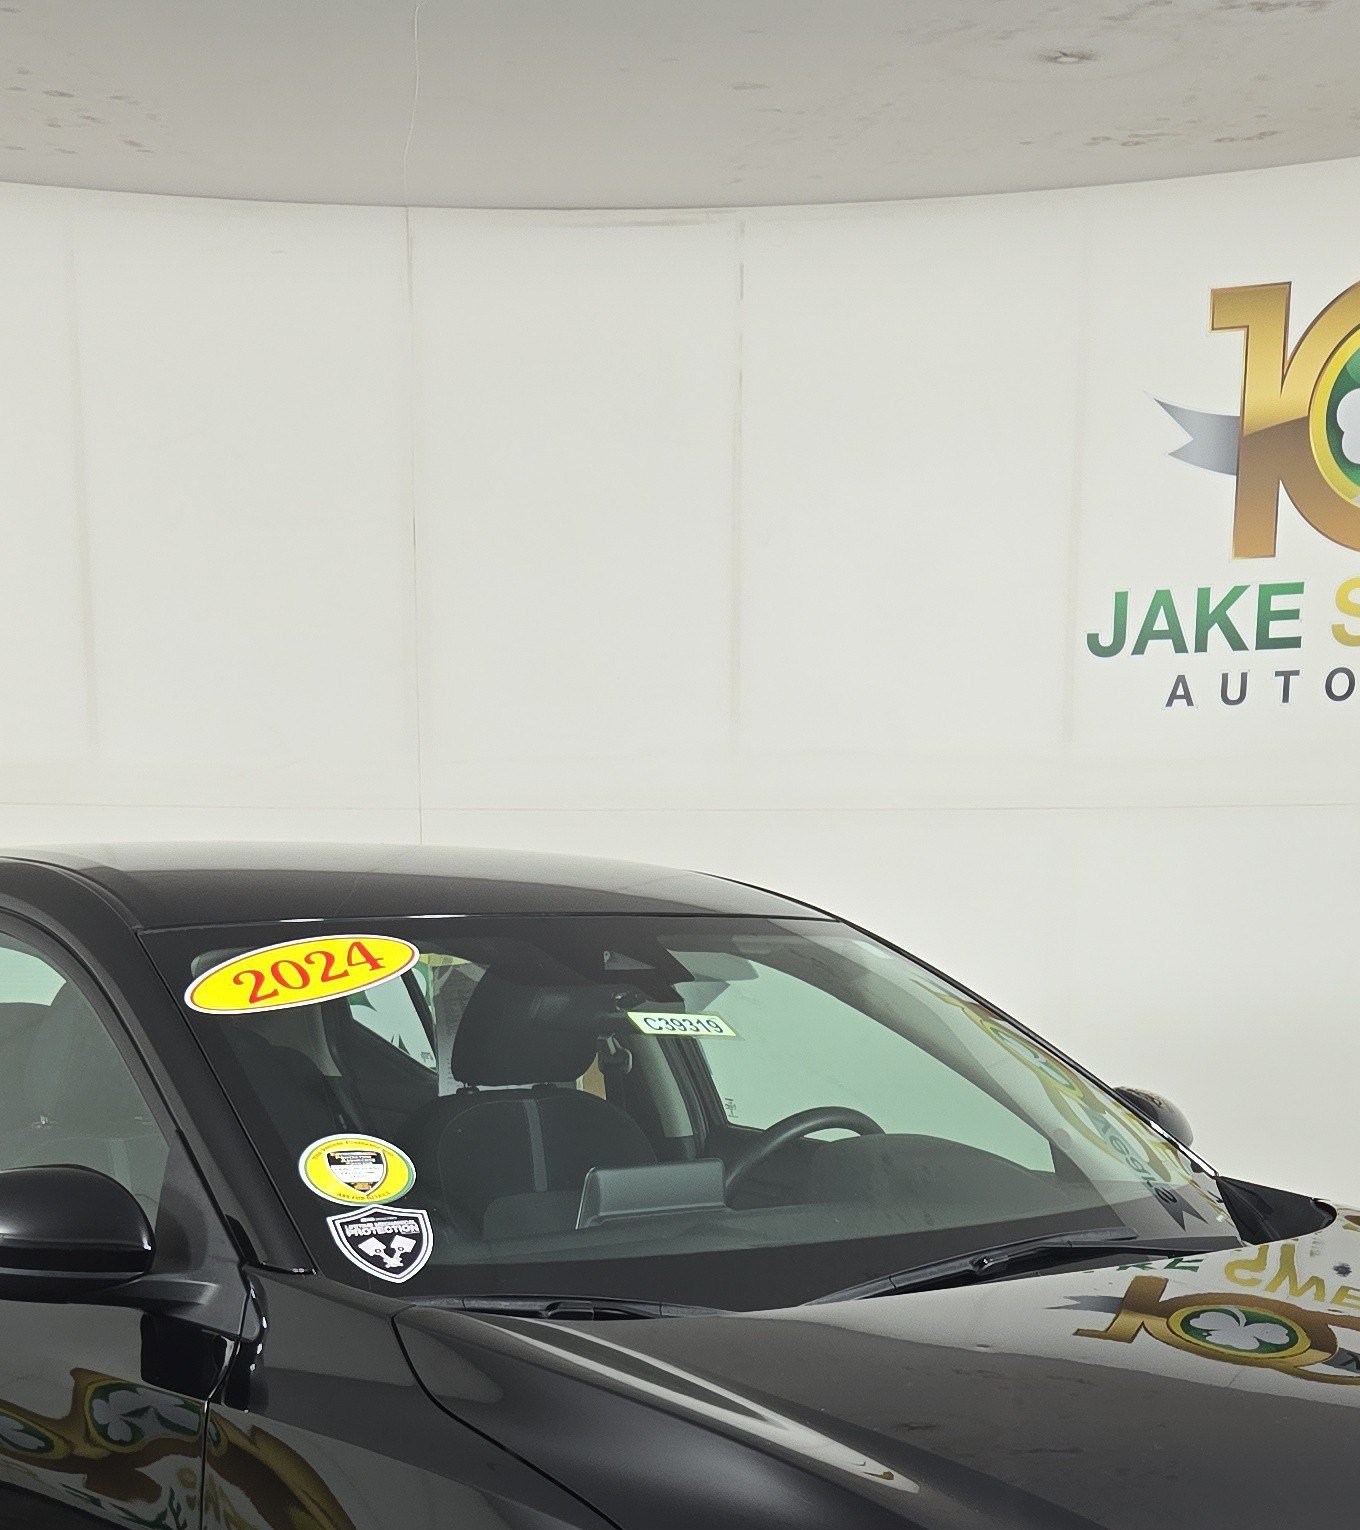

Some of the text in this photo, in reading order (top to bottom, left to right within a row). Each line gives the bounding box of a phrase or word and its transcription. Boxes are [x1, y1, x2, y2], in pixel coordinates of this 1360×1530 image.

[1086, 580, 1305, 659] JAKE
[232, 941, 384, 1004] 2024
[642, 1016, 724, 1034] C39319
